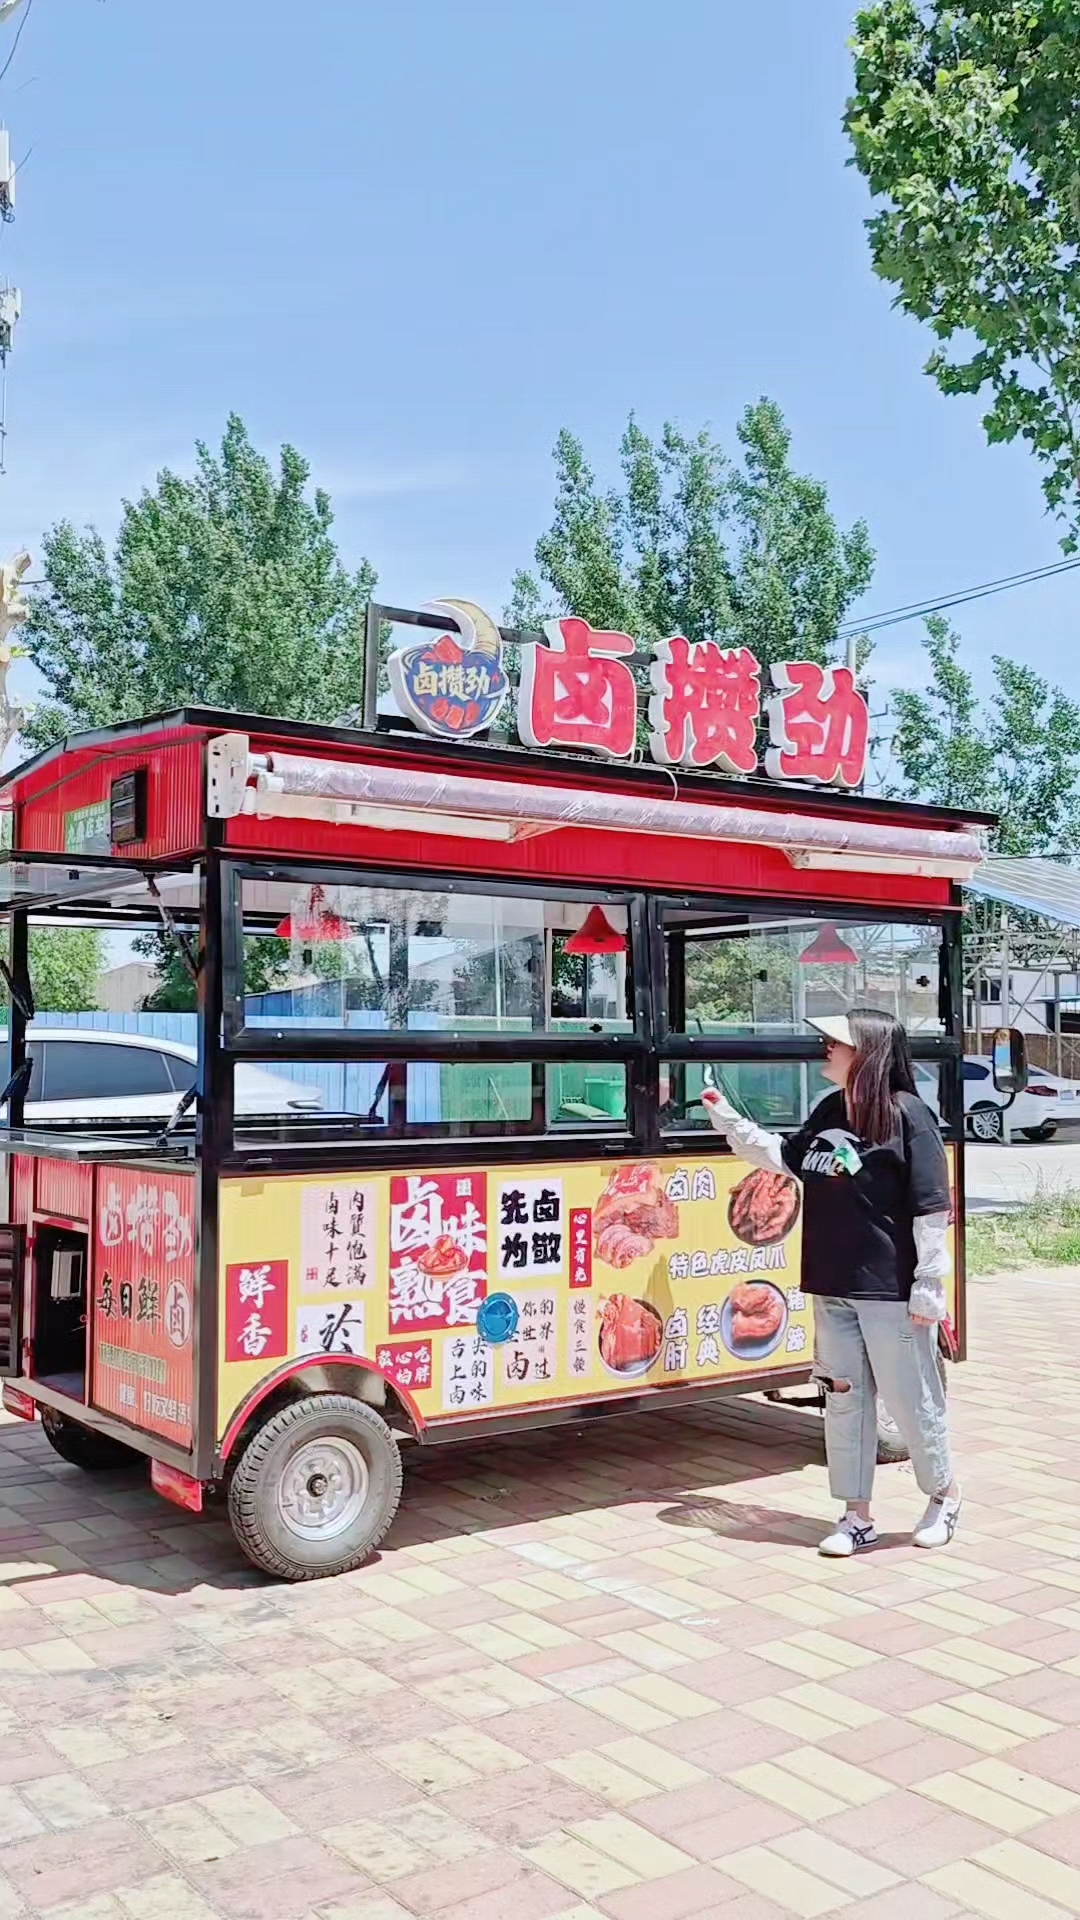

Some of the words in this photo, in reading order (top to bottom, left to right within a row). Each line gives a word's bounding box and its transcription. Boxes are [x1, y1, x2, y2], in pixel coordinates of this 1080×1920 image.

[413, 661, 491, 702] 卤攒劲
[518, 616, 868, 788] 卤攒劲
[665, 1167, 716, 1201] 卤肉
[501, 1188, 560, 1225] 先卤
[322, 1192, 344, 1288] 卤味十足
[669, 1244, 787, 1280] 特色虎皮凤爪
[696, 1304, 720, 1367] 经典
[388, 1365, 431, 1386] 怕胖
